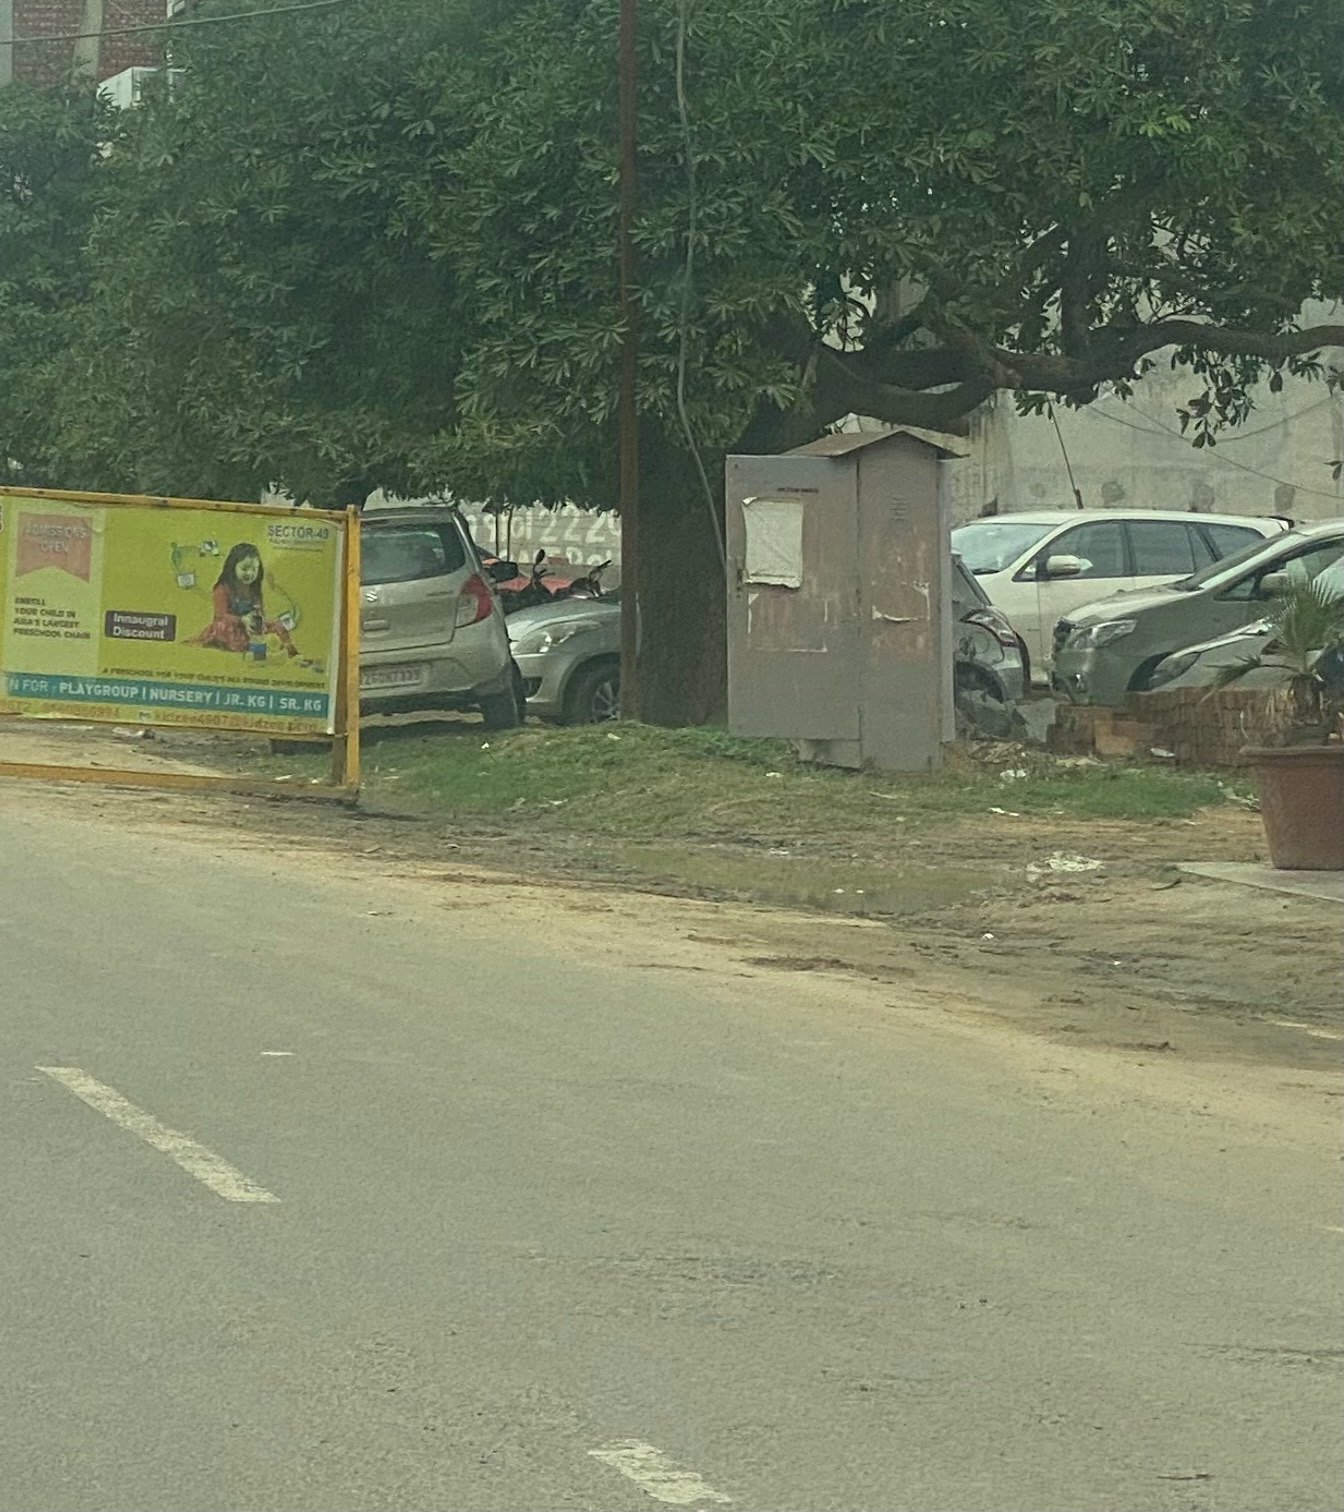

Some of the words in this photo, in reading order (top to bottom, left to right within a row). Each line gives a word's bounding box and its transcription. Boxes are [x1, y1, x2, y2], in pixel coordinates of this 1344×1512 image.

[25, 521, 87, 538] ADMISSIONS
[40, 541, 69, 553] OPEN
[14, 607, 38, 616] YOUR
[40, 609, 65, 618] CHILD
[67, 610, 76, 619] IN
[113, 612, 169, 627] Innaugral
[113, 625, 165, 639] Discount
[22, 679, 49, 693] FOR
[59, 681, 139, 699] PLAYGROUP
[149, 688, 214, 705] NURSERY
[223, 695, 245, 707] JR.
[247, 695, 267, 709] KG
[279, 697, 301, 710] SR.
[303, 699, 322, 712] KG
